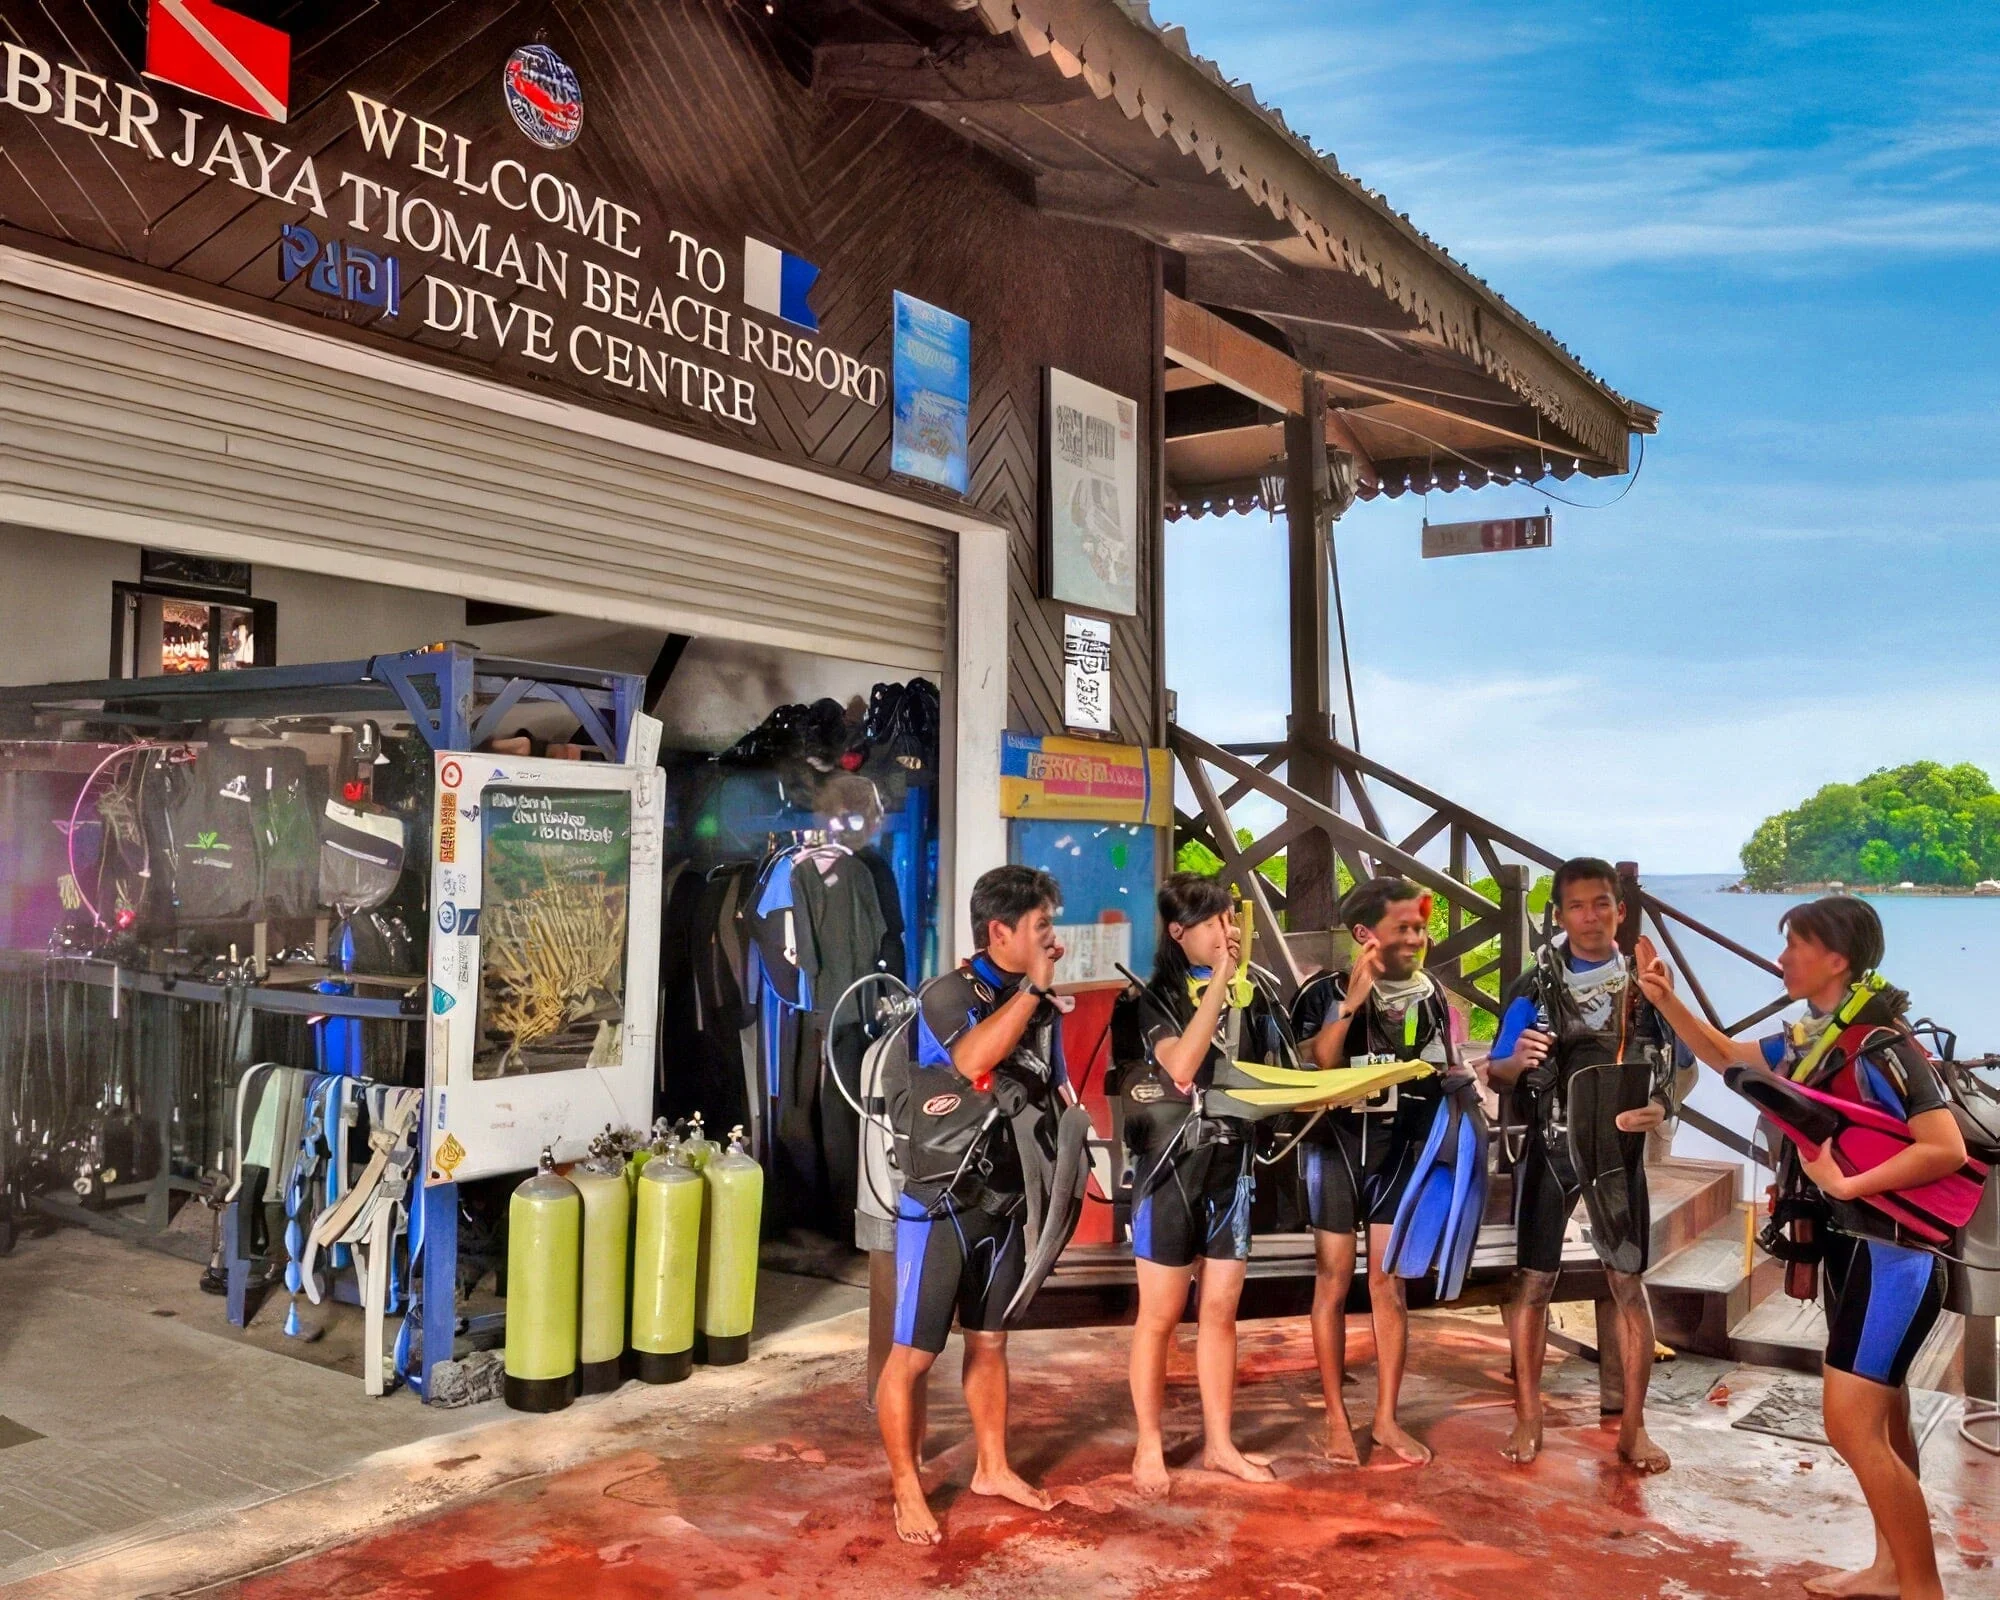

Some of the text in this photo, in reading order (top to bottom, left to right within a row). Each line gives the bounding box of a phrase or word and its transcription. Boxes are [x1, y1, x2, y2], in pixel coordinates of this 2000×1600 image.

[0, 41, 887, 407] BERJAYA TIOMAN BEACH RESORT
[347, 90, 642, 259] WELCOME
[669, 229, 726, 294] TO
[423, 274, 758, 426] DIVE CENTRE
